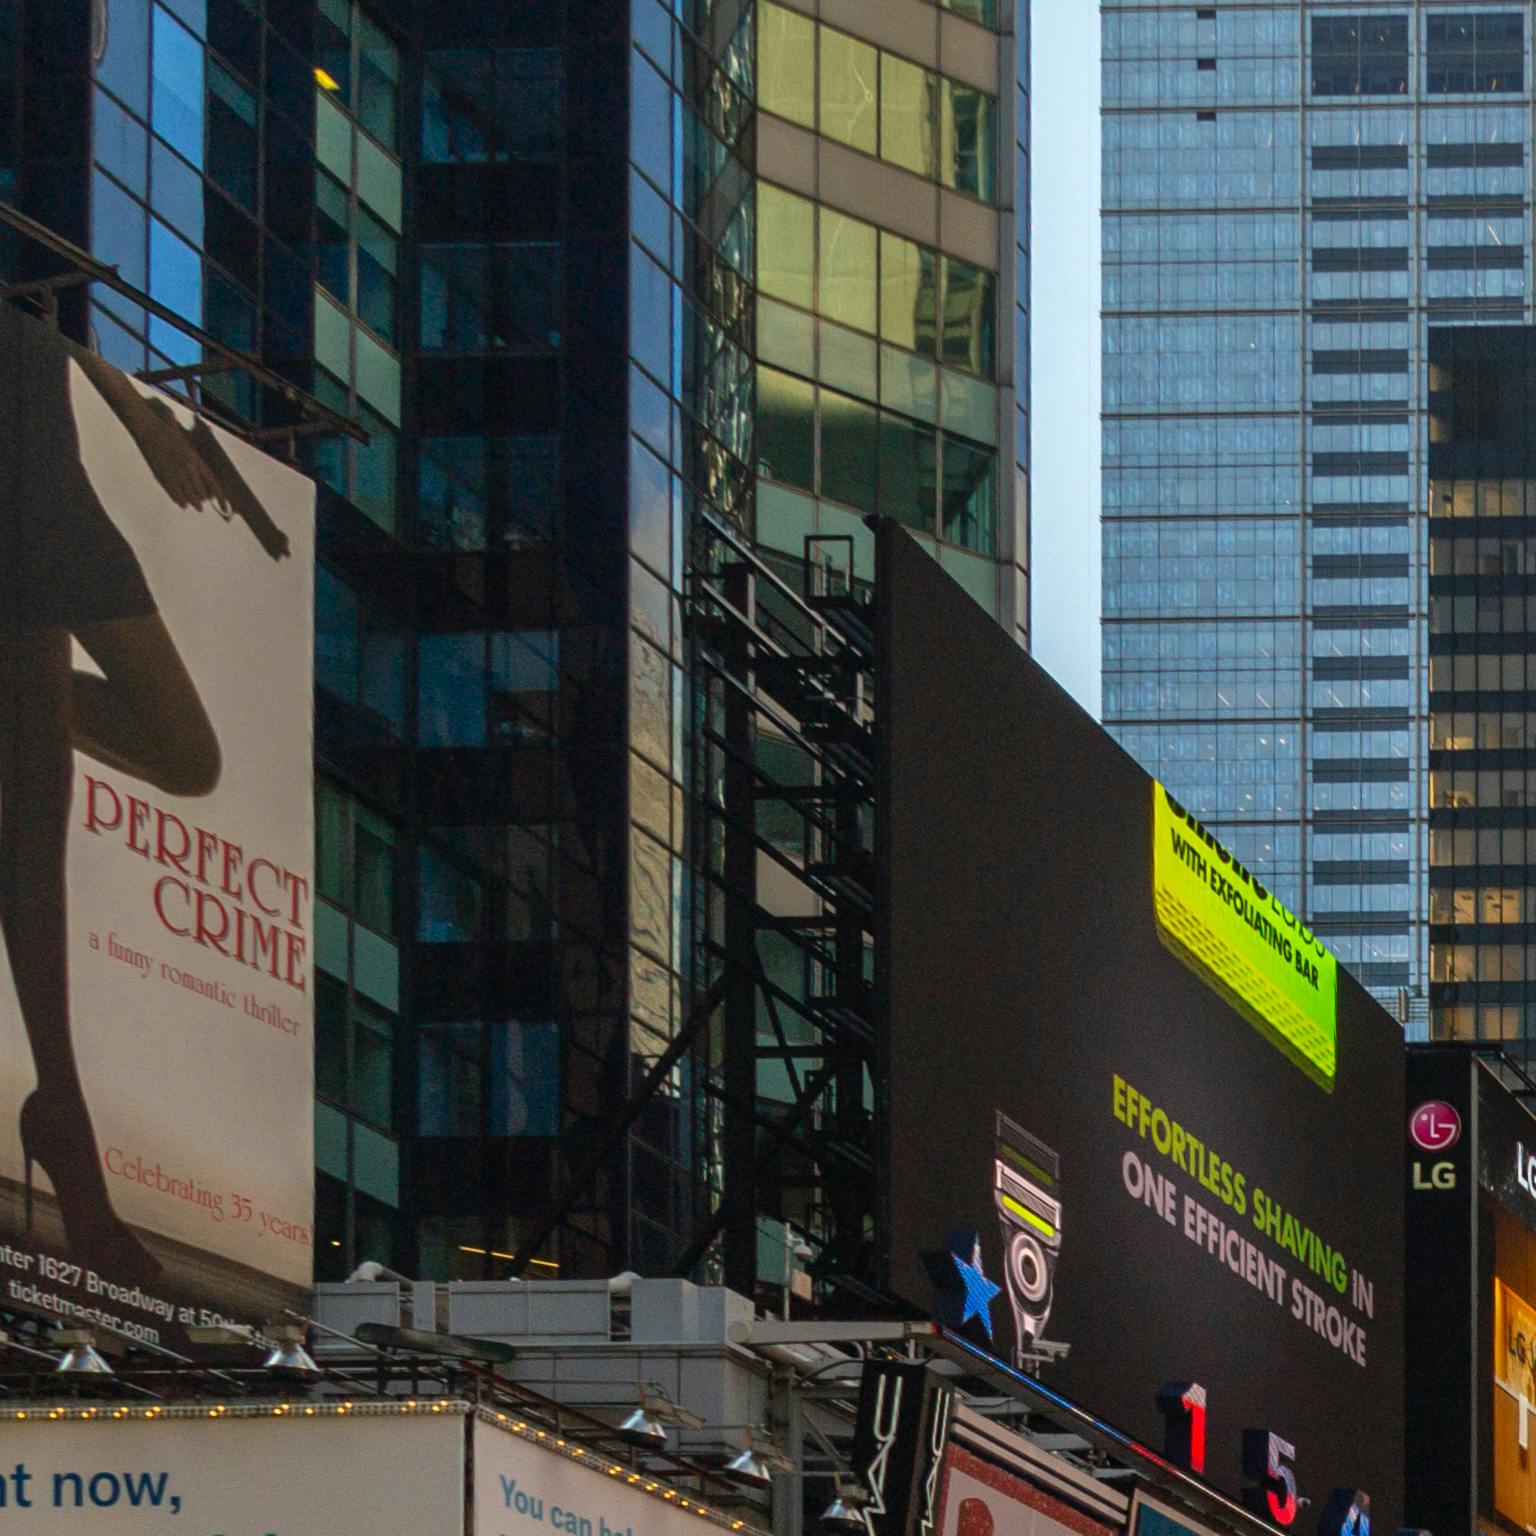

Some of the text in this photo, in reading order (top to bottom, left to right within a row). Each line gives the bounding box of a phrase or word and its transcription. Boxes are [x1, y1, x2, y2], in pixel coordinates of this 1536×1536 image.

[83, 775, 309, 930] PERFECT
[153, 876, 308, 994] CRIME
[1170, 826, 1208, 884] WITH
[1210, 865, 1293, 964] EXFOLIATING
[1295, 950, 1320, 991] BAR
[88, 932, 301, 1037] a funny romantic thriller
[103, 1147, 254, 1224] Celebrating 35
[1113, 1072, 1375, 1320] EFFORTLESS SHAVING IN
[1412, 1161, 1457, 1191] LG
[38, 1252, 195, 1328] 1627 Broadway at
[1122, 1150, 1368, 1369] ONE EFFICIENT STROKE
[8, 1278, 160, 1345] ticketmaster.com
[52, 1471, 182, 1515] now,
[499, 1473, 543, 1521] You
